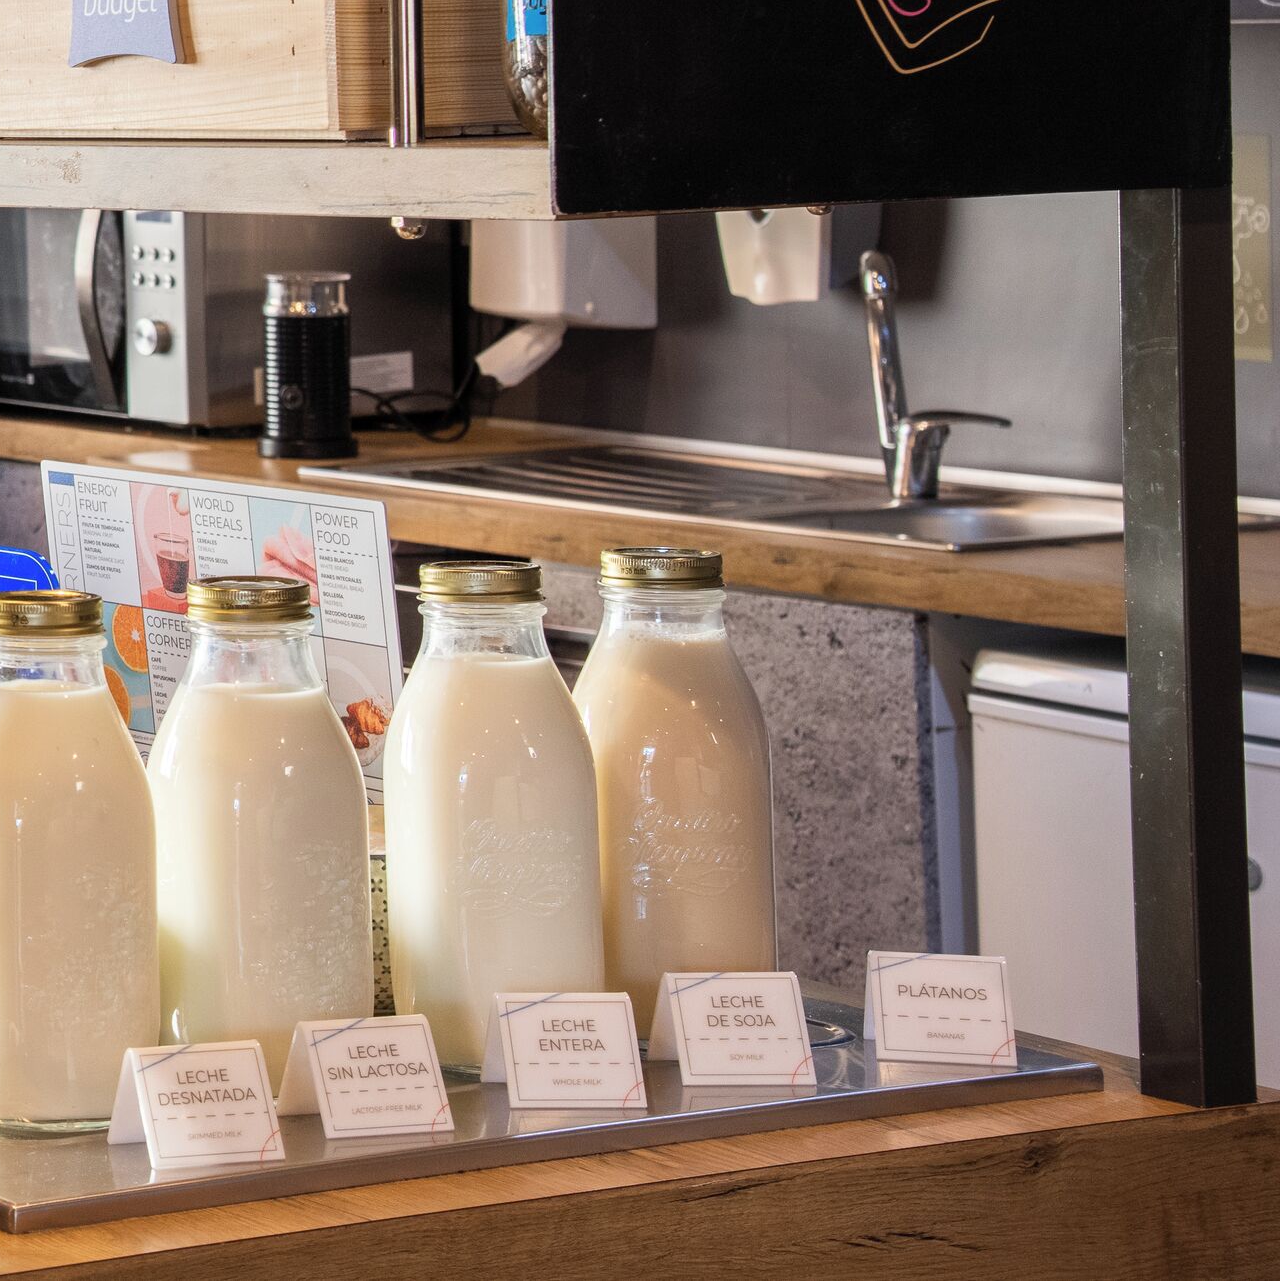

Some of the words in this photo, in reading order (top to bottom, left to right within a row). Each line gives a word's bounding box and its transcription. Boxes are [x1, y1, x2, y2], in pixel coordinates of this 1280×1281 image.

[77, 481, 118, 498] ENERGY
[79, 498, 108, 513] FRUIT
[192, 496, 235, 513] WORLD
[81, 521, 95, 529] FRUTA
[194, 513, 243, 532] CEREALS
[315, 511, 359, 529] POWER
[56, 492, 78, 592] RNERS
[196, 538, 218, 546] CEREALES
[316, 530, 351, 546] FOOD
[86, 563, 100, 571] ZUMOS
[106, 566, 122, 574] FRUTAS
[324, 609, 347, 619] BIZCOCHO
[347, 612, 366, 621] CASERO
[146, 614, 189, 634] COFFEE
[148, 632, 192, 650] CORNER
[152, 674, 177, 683] INFUSIONES
[897, 983, 988, 1001] PLÁTANOS
[710, 995, 765, 1008] LECHE
[541, 1019, 597, 1032] LECHE
[706, 1014, 730, 1027] DE
[733, 1014, 776, 1027] SOJA
[926, 1031, 966, 1040] BANANAS
[347, 1044, 401, 1060] LECHE
[538, 1038, 606, 1052] ENTERA
[729, 1053, 745, 1061] SOY
[175, 1068, 230, 1085] LECHE
[327, 1067, 354, 1080] SIN
[358, 1062, 430, 1079] LACTOSA
[552, 1078, 581, 1086] WHOLE
[583, 1078, 603, 1086] MILK
[157, 1087, 258, 1107] DESNATADA
[404, 1103, 423, 1112] MILK
[187, 1132, 224, 1141] SKIMMED
[223, 1130, 243, 1139] MILK
